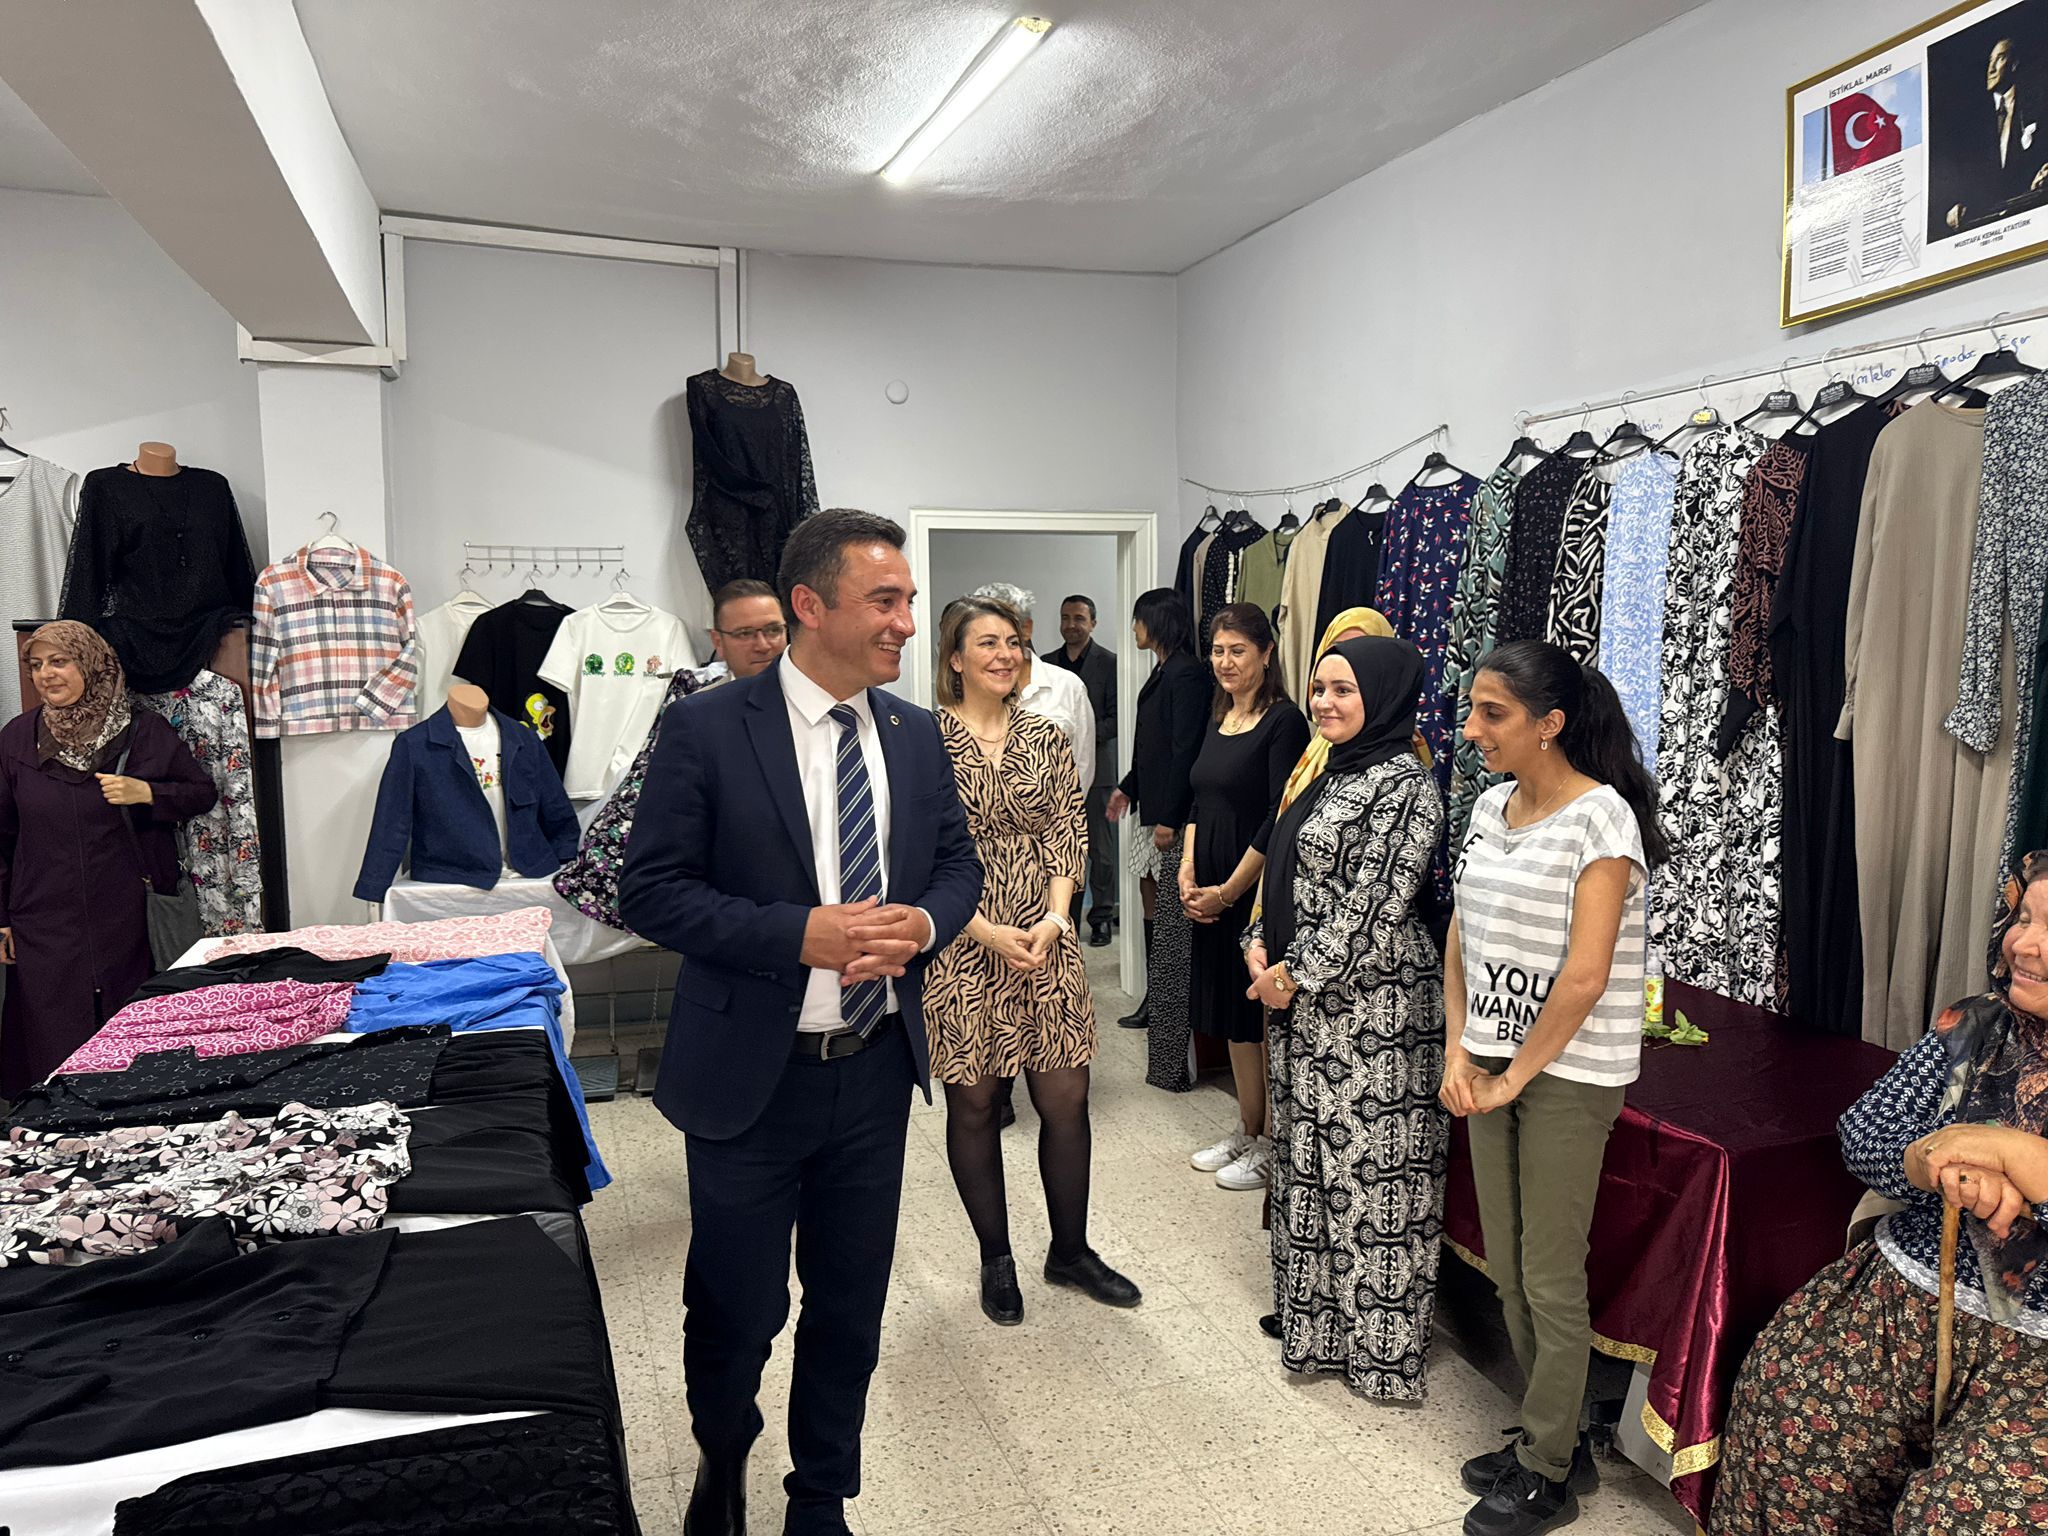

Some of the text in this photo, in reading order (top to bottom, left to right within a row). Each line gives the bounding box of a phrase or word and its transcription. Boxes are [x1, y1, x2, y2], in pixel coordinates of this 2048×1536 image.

[1828, 78, 1865, 99] İSTİKLAL
[1982, 229, 2002, 239] KEMAL
[1484, 962, 1554, 1003] YOU
[1471, 990, 1544, 1025] WANN
